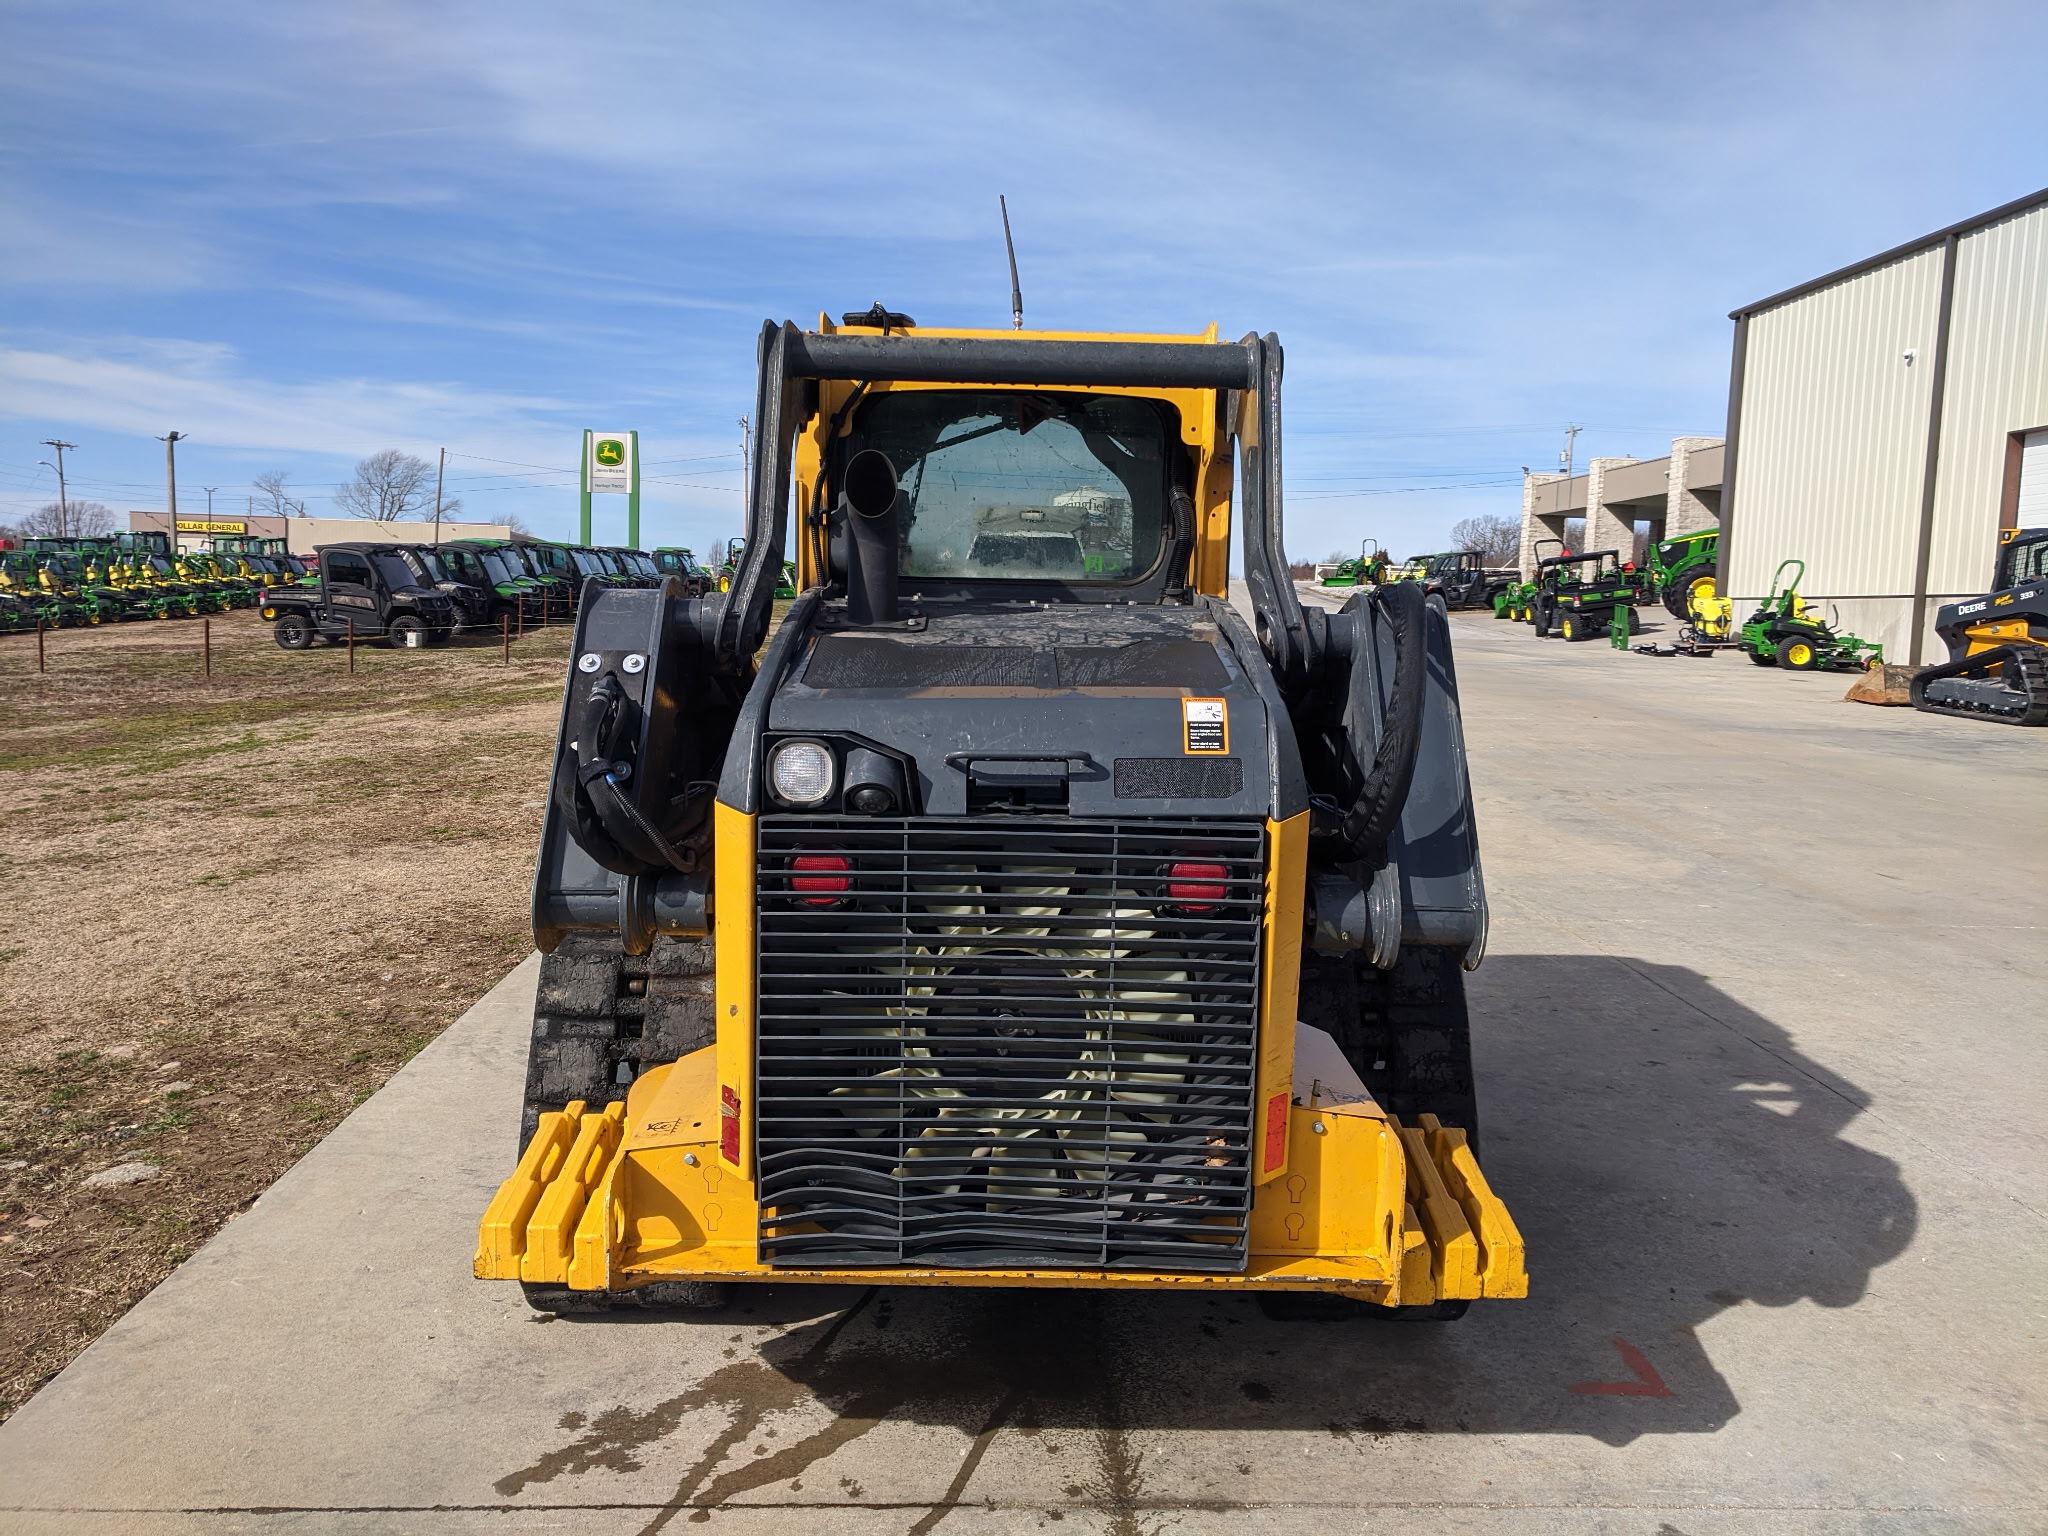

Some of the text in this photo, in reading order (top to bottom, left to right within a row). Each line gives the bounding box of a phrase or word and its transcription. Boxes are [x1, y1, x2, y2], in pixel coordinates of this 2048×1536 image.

[176, 522, 243, 532] OLLAR GENERAL
[1958, 601, 1987, 615] DEERE
